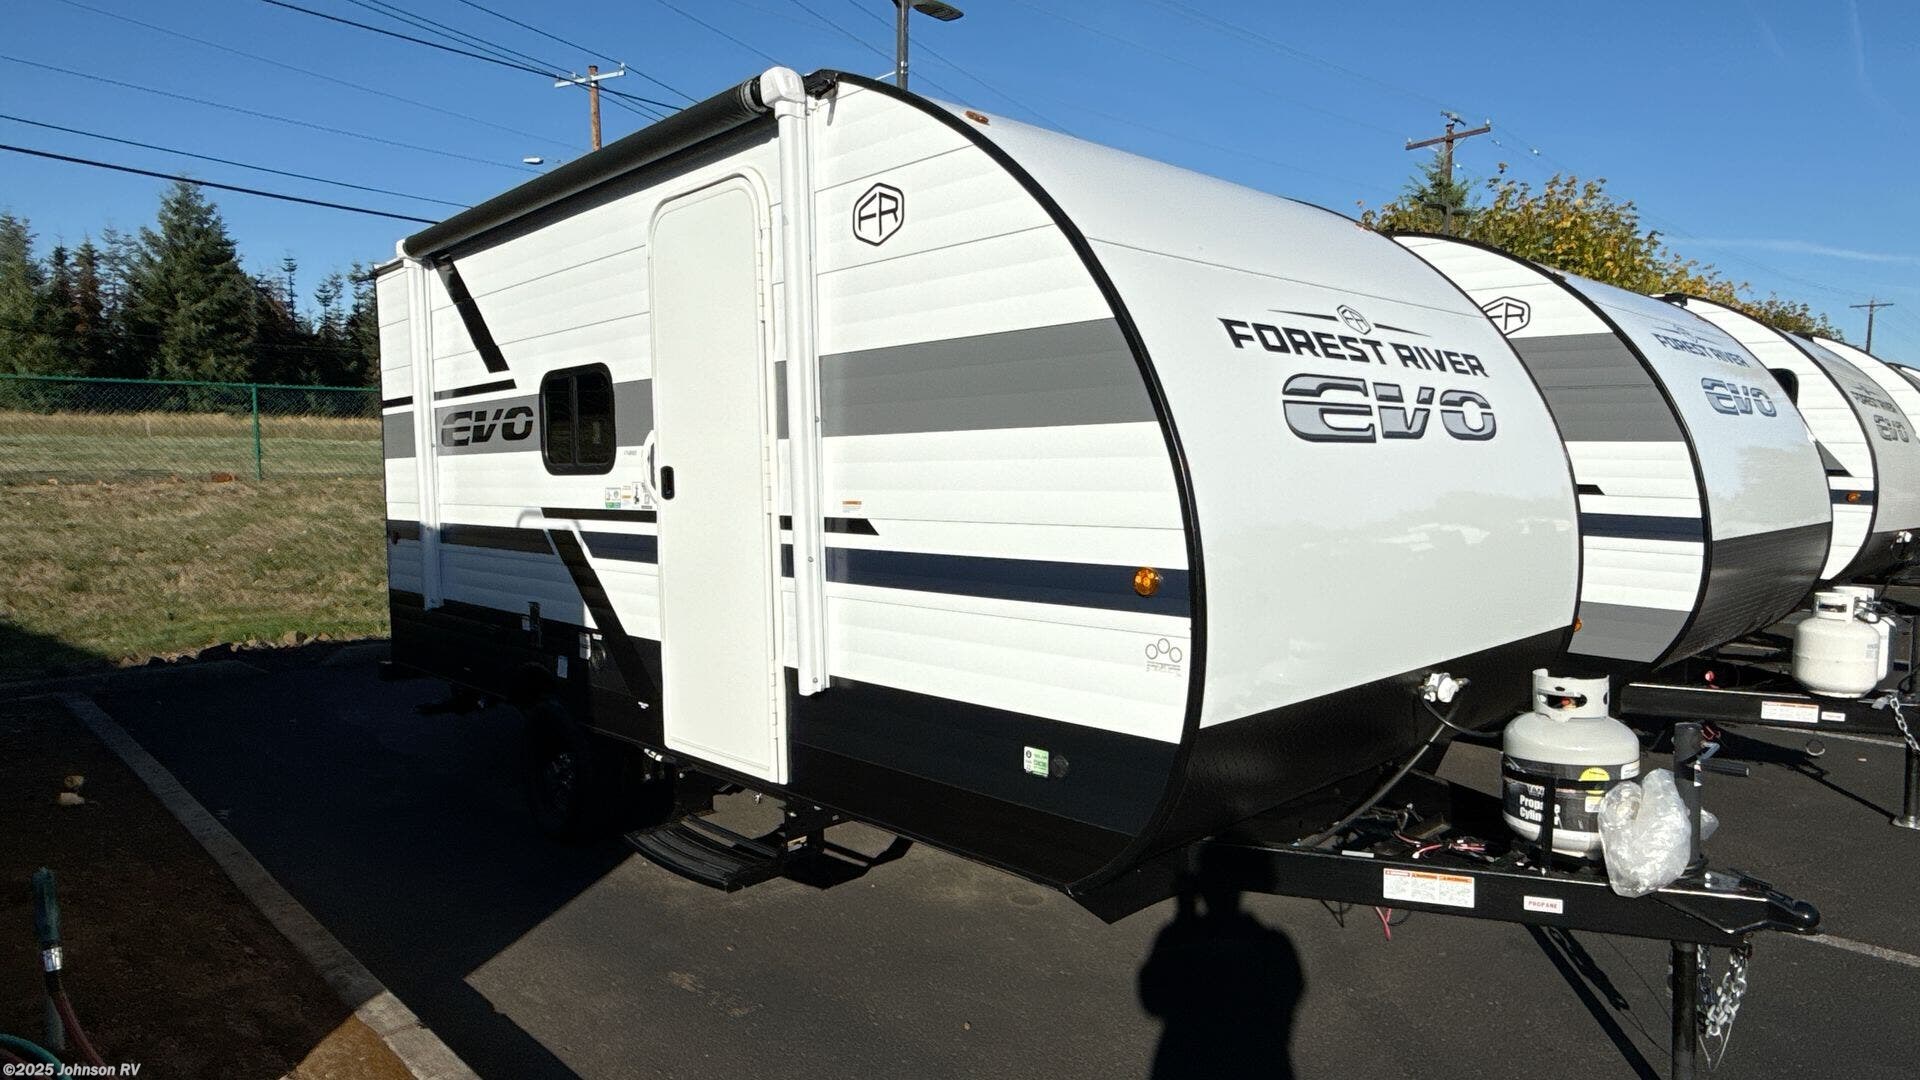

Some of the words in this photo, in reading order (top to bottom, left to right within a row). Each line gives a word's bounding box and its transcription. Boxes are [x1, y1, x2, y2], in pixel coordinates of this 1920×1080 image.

[1217, 317, 1387, 365] FOREST
[1389, 342, 1490, 378] RIVER
[1651, 332, 1713, 359] FOREST
[1708, 347, 1751, 368] RIVER
[1282, 373, 1497, 444] EVO
[1701, 377, 1777, 417] EVO
[441, 405, 534, 447] EVO
